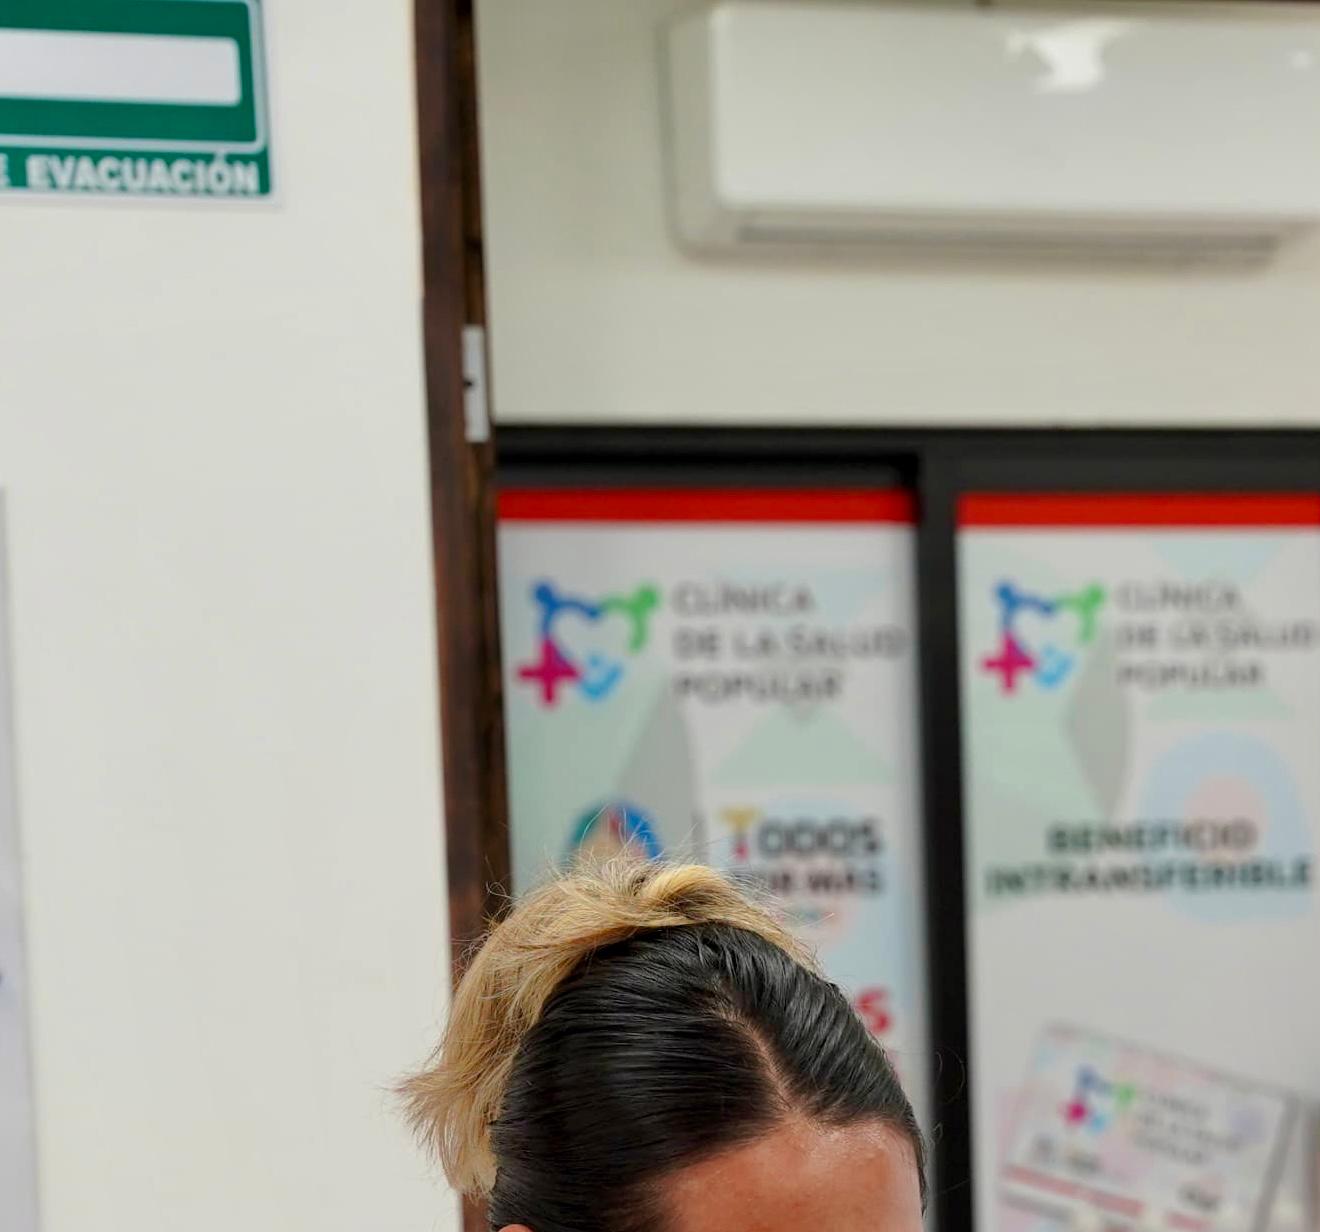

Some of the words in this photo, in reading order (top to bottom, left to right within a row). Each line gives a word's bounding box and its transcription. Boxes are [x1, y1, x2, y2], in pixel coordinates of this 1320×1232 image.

[26, 151, 259, 193] EVACUACIÓN
[1049, 821, 1255, 852] BENEFICIO
[989, 858, 1309, 893] INTRANSFERIBLE
